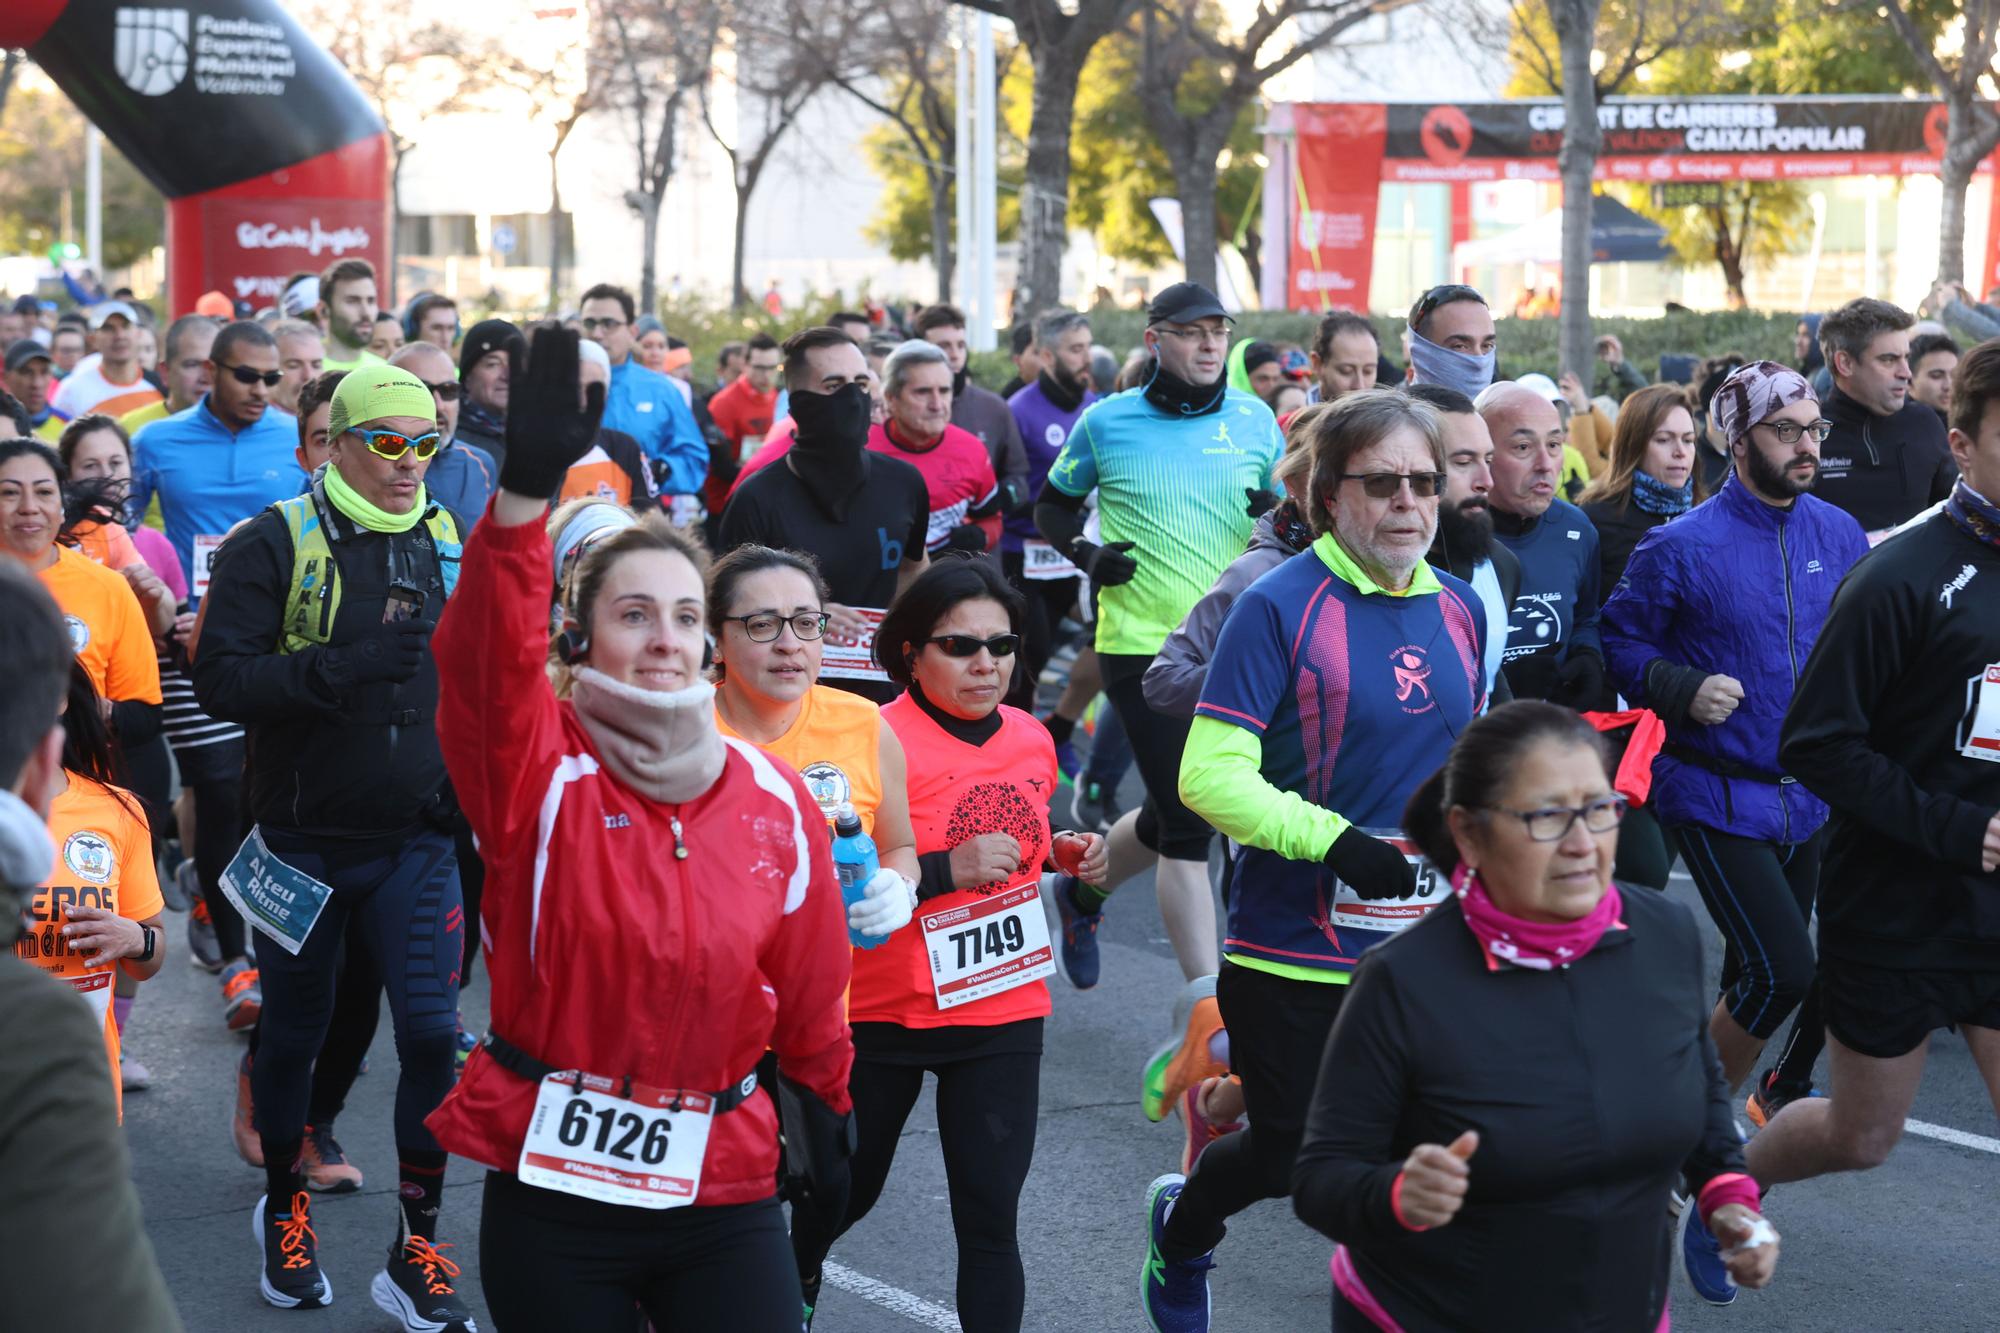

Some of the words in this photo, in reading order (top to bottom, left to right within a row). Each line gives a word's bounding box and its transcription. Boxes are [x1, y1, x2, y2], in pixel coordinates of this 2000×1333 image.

[1622, 104, 1655, 129] DE
[1655, 102, 1778, 130] CARRERES
[247, 876, 291, 921] Ritme
[263, 874, 296, 905] teu
[948, 914, 1025, 970] 7749
[966, 963, 1020, 985] #ValènciaCorre
[557, 1098, 672, 1165] 6126
[563, 1160, 642, 1187] #ValènciaCorre
